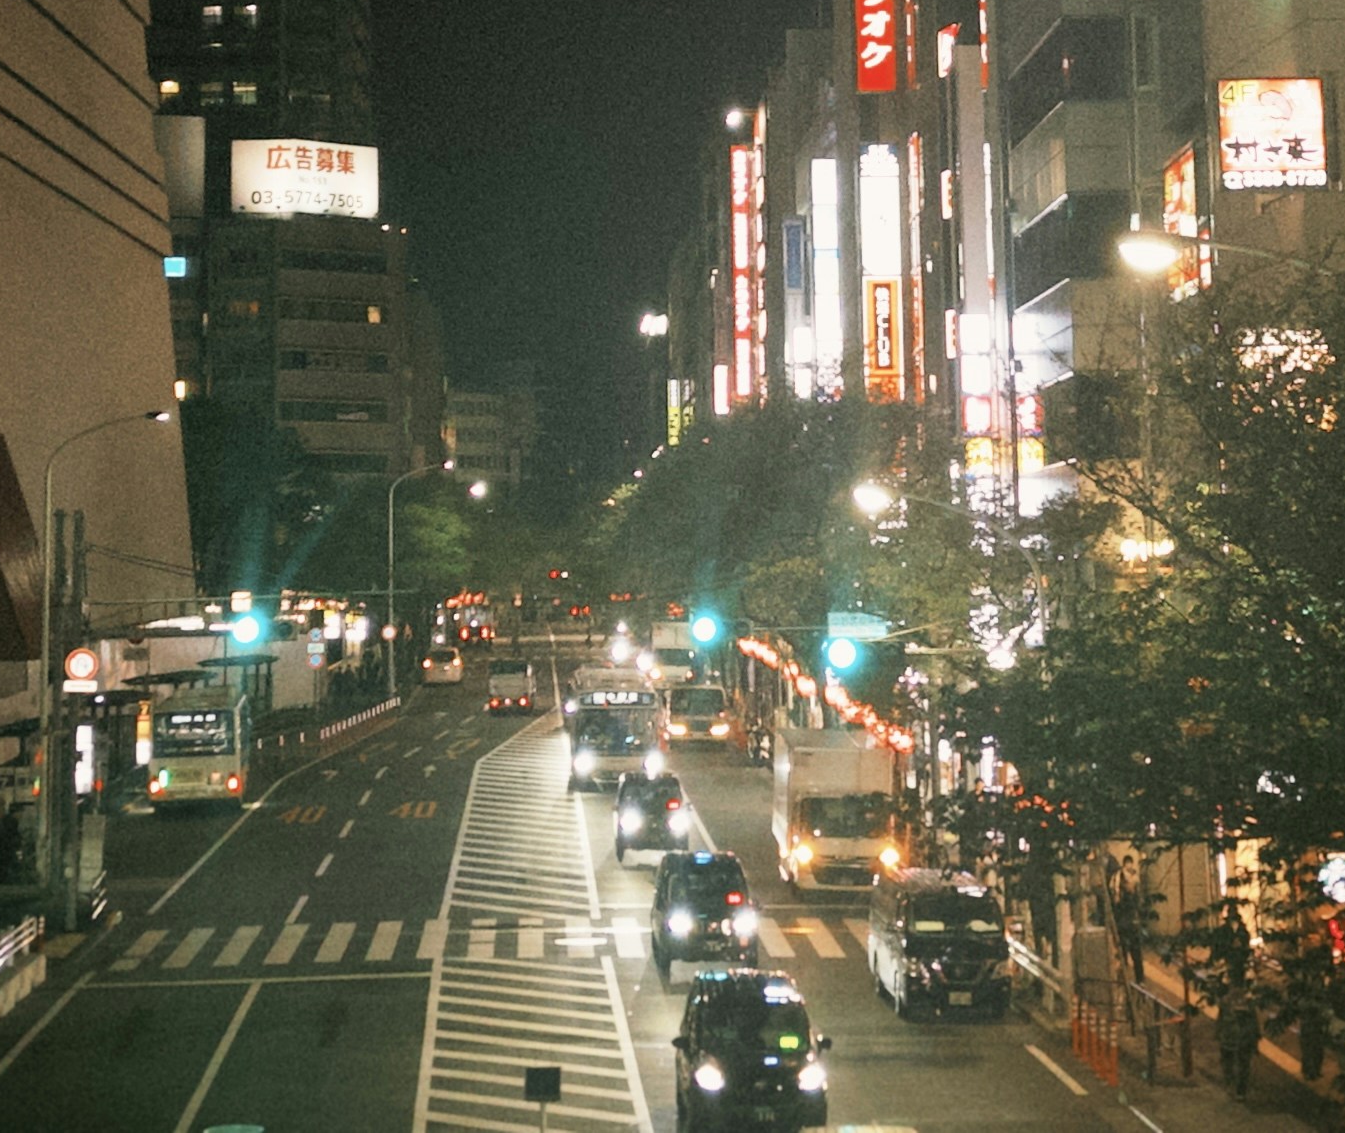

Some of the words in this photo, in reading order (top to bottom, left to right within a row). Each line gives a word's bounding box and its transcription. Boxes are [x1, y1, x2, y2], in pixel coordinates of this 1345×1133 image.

[1222, 84, 1255, 104] 4F
[266, 145, 356, 175] 広告募集
[251, 189, 364, 209] 03-5774-7505
